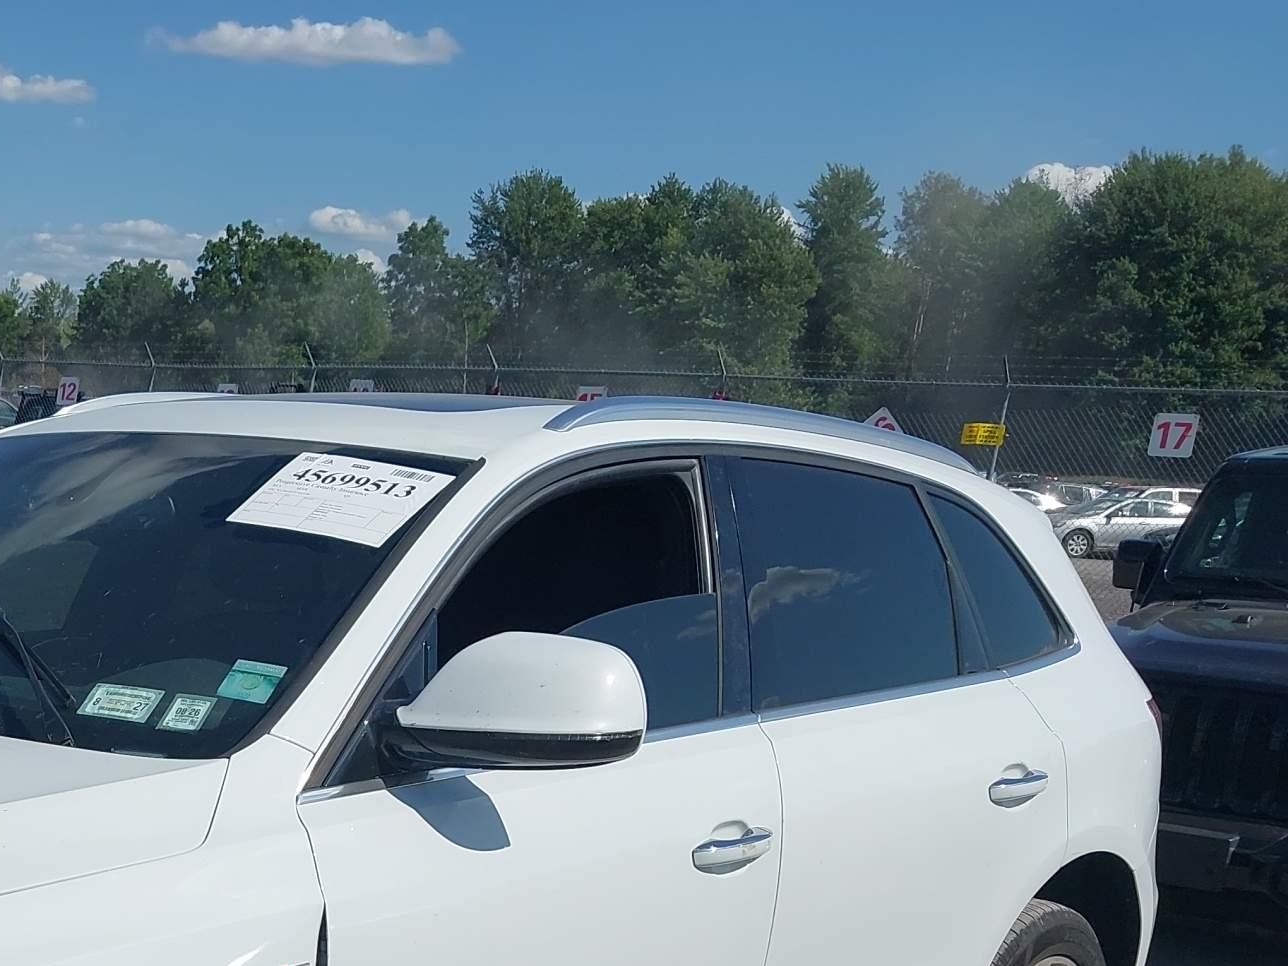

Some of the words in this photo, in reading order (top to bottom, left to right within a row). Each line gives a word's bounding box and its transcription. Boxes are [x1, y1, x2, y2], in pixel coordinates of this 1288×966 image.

[59, 382, 77, 402] 12
[1156, 421, 1194, 450] 17
[292, 467, 417, 499] 45699513
[133, 701, 148, 711] 27
